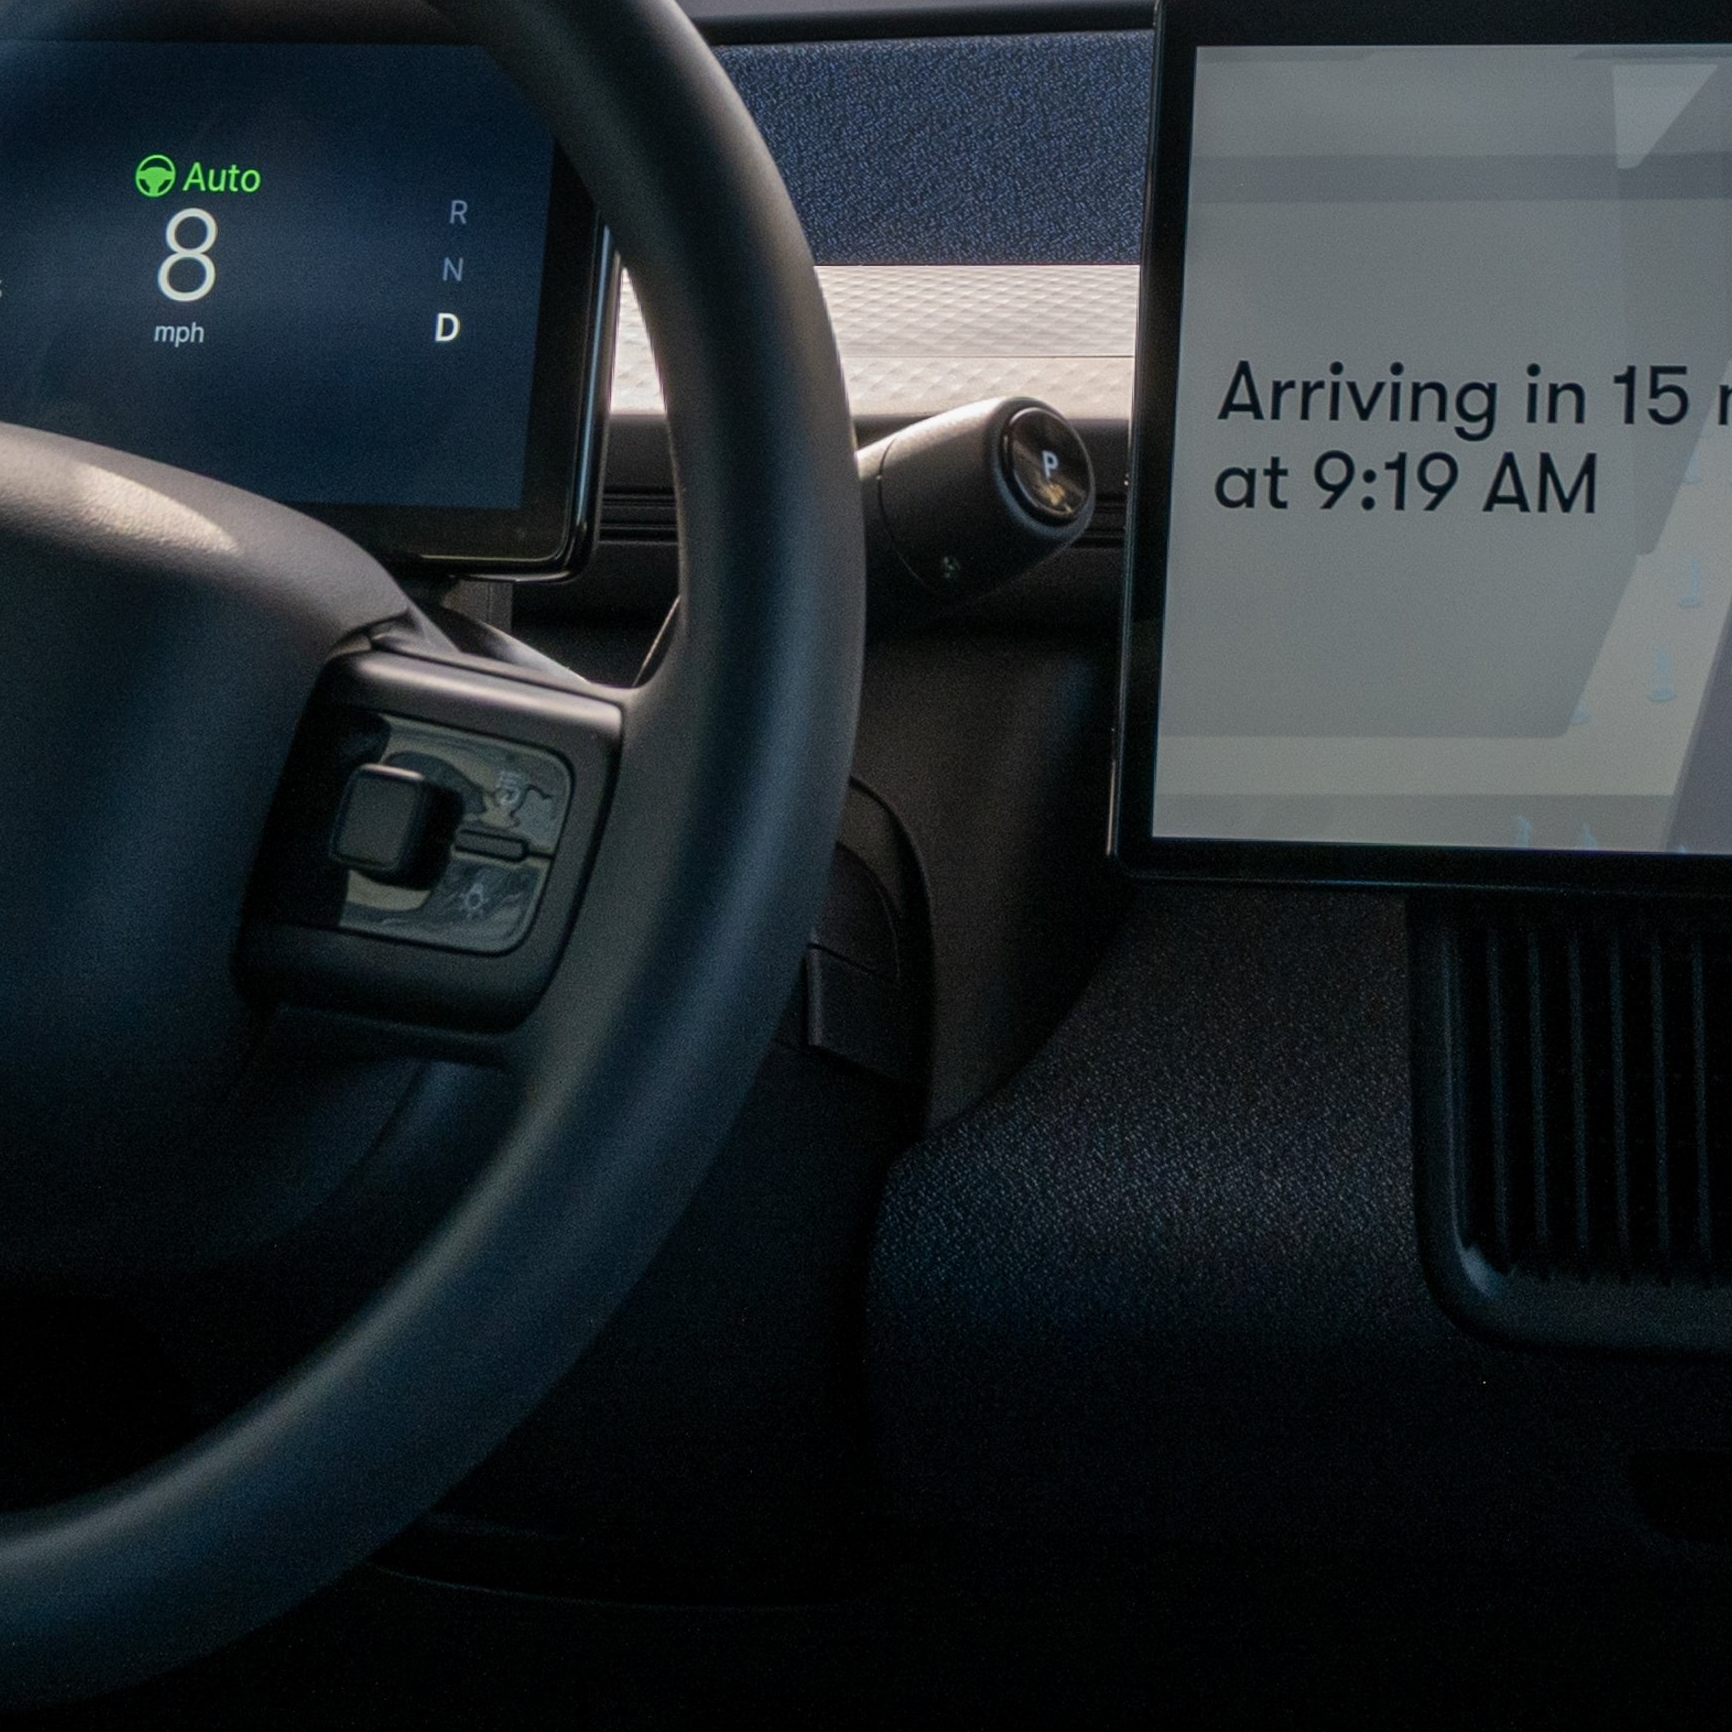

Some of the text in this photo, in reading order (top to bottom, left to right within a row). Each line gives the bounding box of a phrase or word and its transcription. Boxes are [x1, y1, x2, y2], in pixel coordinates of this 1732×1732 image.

[182, 161, 262, 193] Auto
[449, 200, 468, 225] R
[157, 207, 218, 302] 8
[442, 257, 464, 282] N
[153, 322, 205, 347] mph
[435, 312, 460, 344] D
[1216, 359, 1498, 442] Arriving
[1525, 362, 1587, 424] in
[1612, 365, 1689, 426] 15
[1042, 449, 1059, 480] P
[1214, 449, 1598, 514] at 9:19 AM
